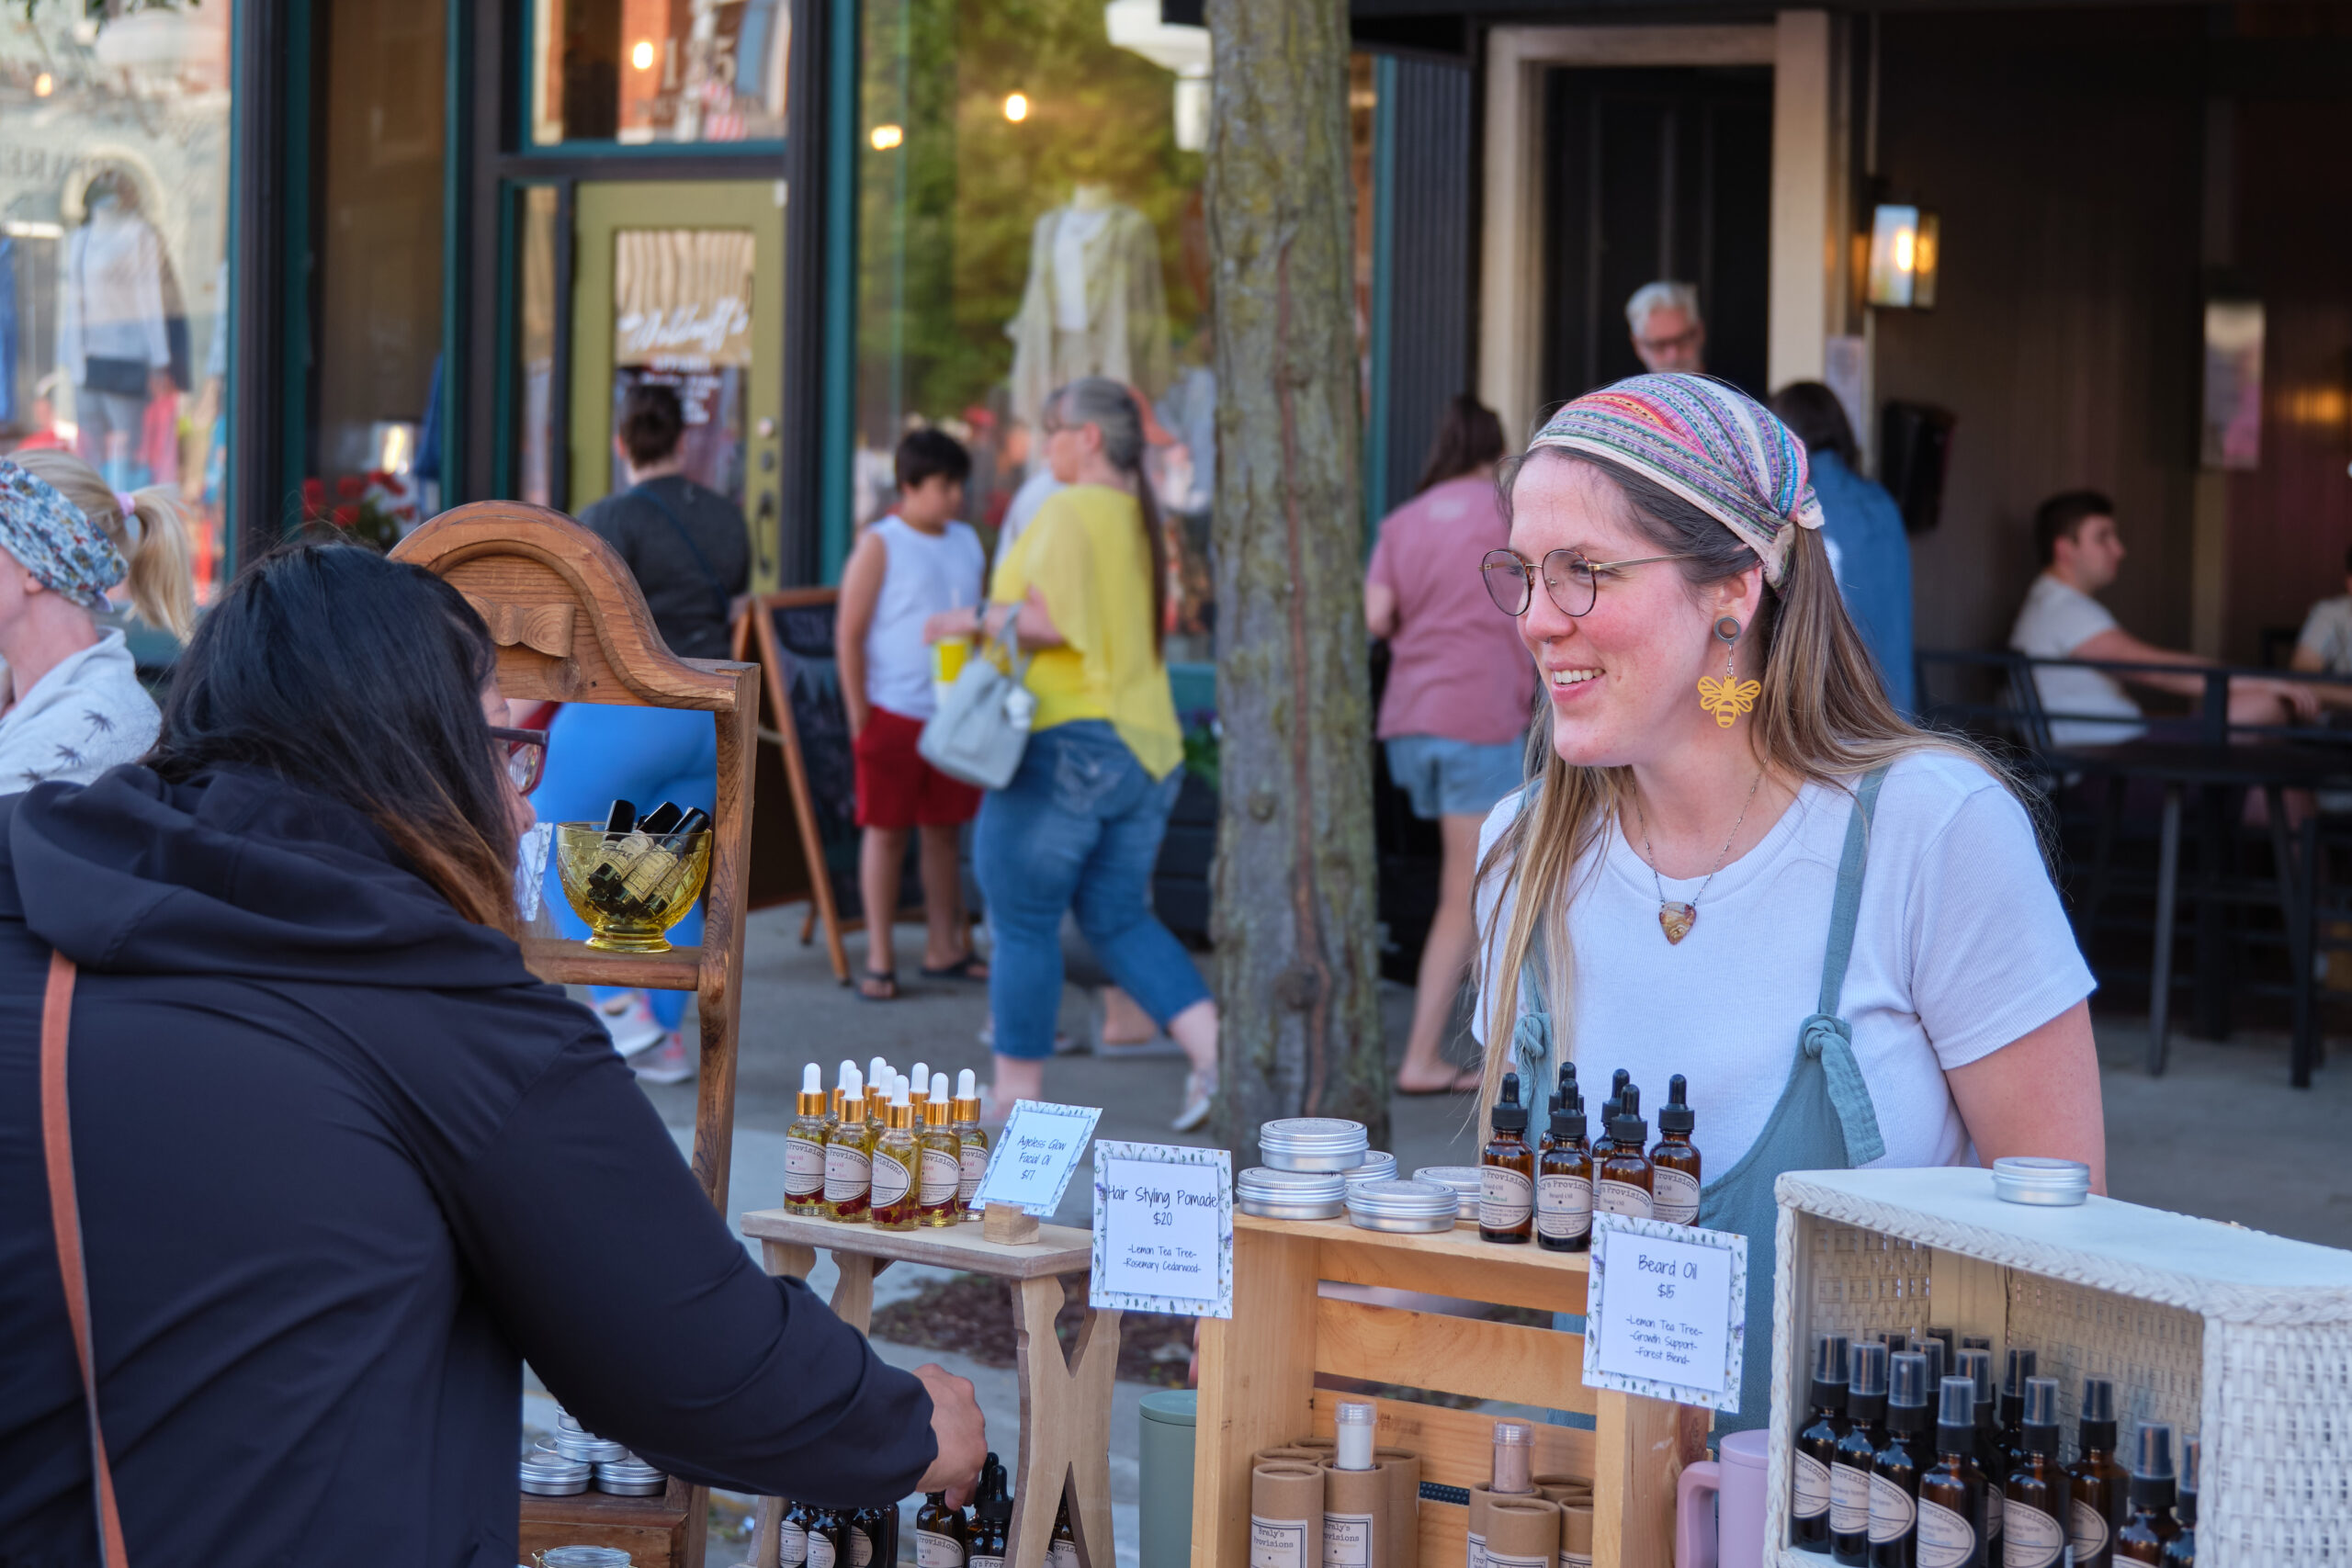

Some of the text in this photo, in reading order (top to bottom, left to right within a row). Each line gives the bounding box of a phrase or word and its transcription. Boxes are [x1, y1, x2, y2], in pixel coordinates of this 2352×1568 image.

[1017, 1135, 1067, 1151] Ageless Glow
[923, 1155, 956, 1171] rovisions
[1019, 1152, 1052, 1166] Facial Oil
[1021, 1168, 1035, 1181] $17
[1108, 1184, 1218, 1209] Hair Styling Pomade
[1153, 1212, 1172, 1226] $20
[1128, 1244, 1197, 1258] -Lemon Tea Tree-
[1123, 1258, 1159, 1273] -Rosemary
[1638, 1254, 1697, 1280] Beard Oil
[1657, 1282, 1676, 1299] $15
[1625, 1314, 1703, 1337] -Lemon Tea Tree-
[1664, 1336, 1698, 1351] Support-
[1634, 1346, 1663, 1359] -Forest
[1254, 1536, 1294, 1548] Provisions
[1323, 1531, 1360, 1542] rovisions
